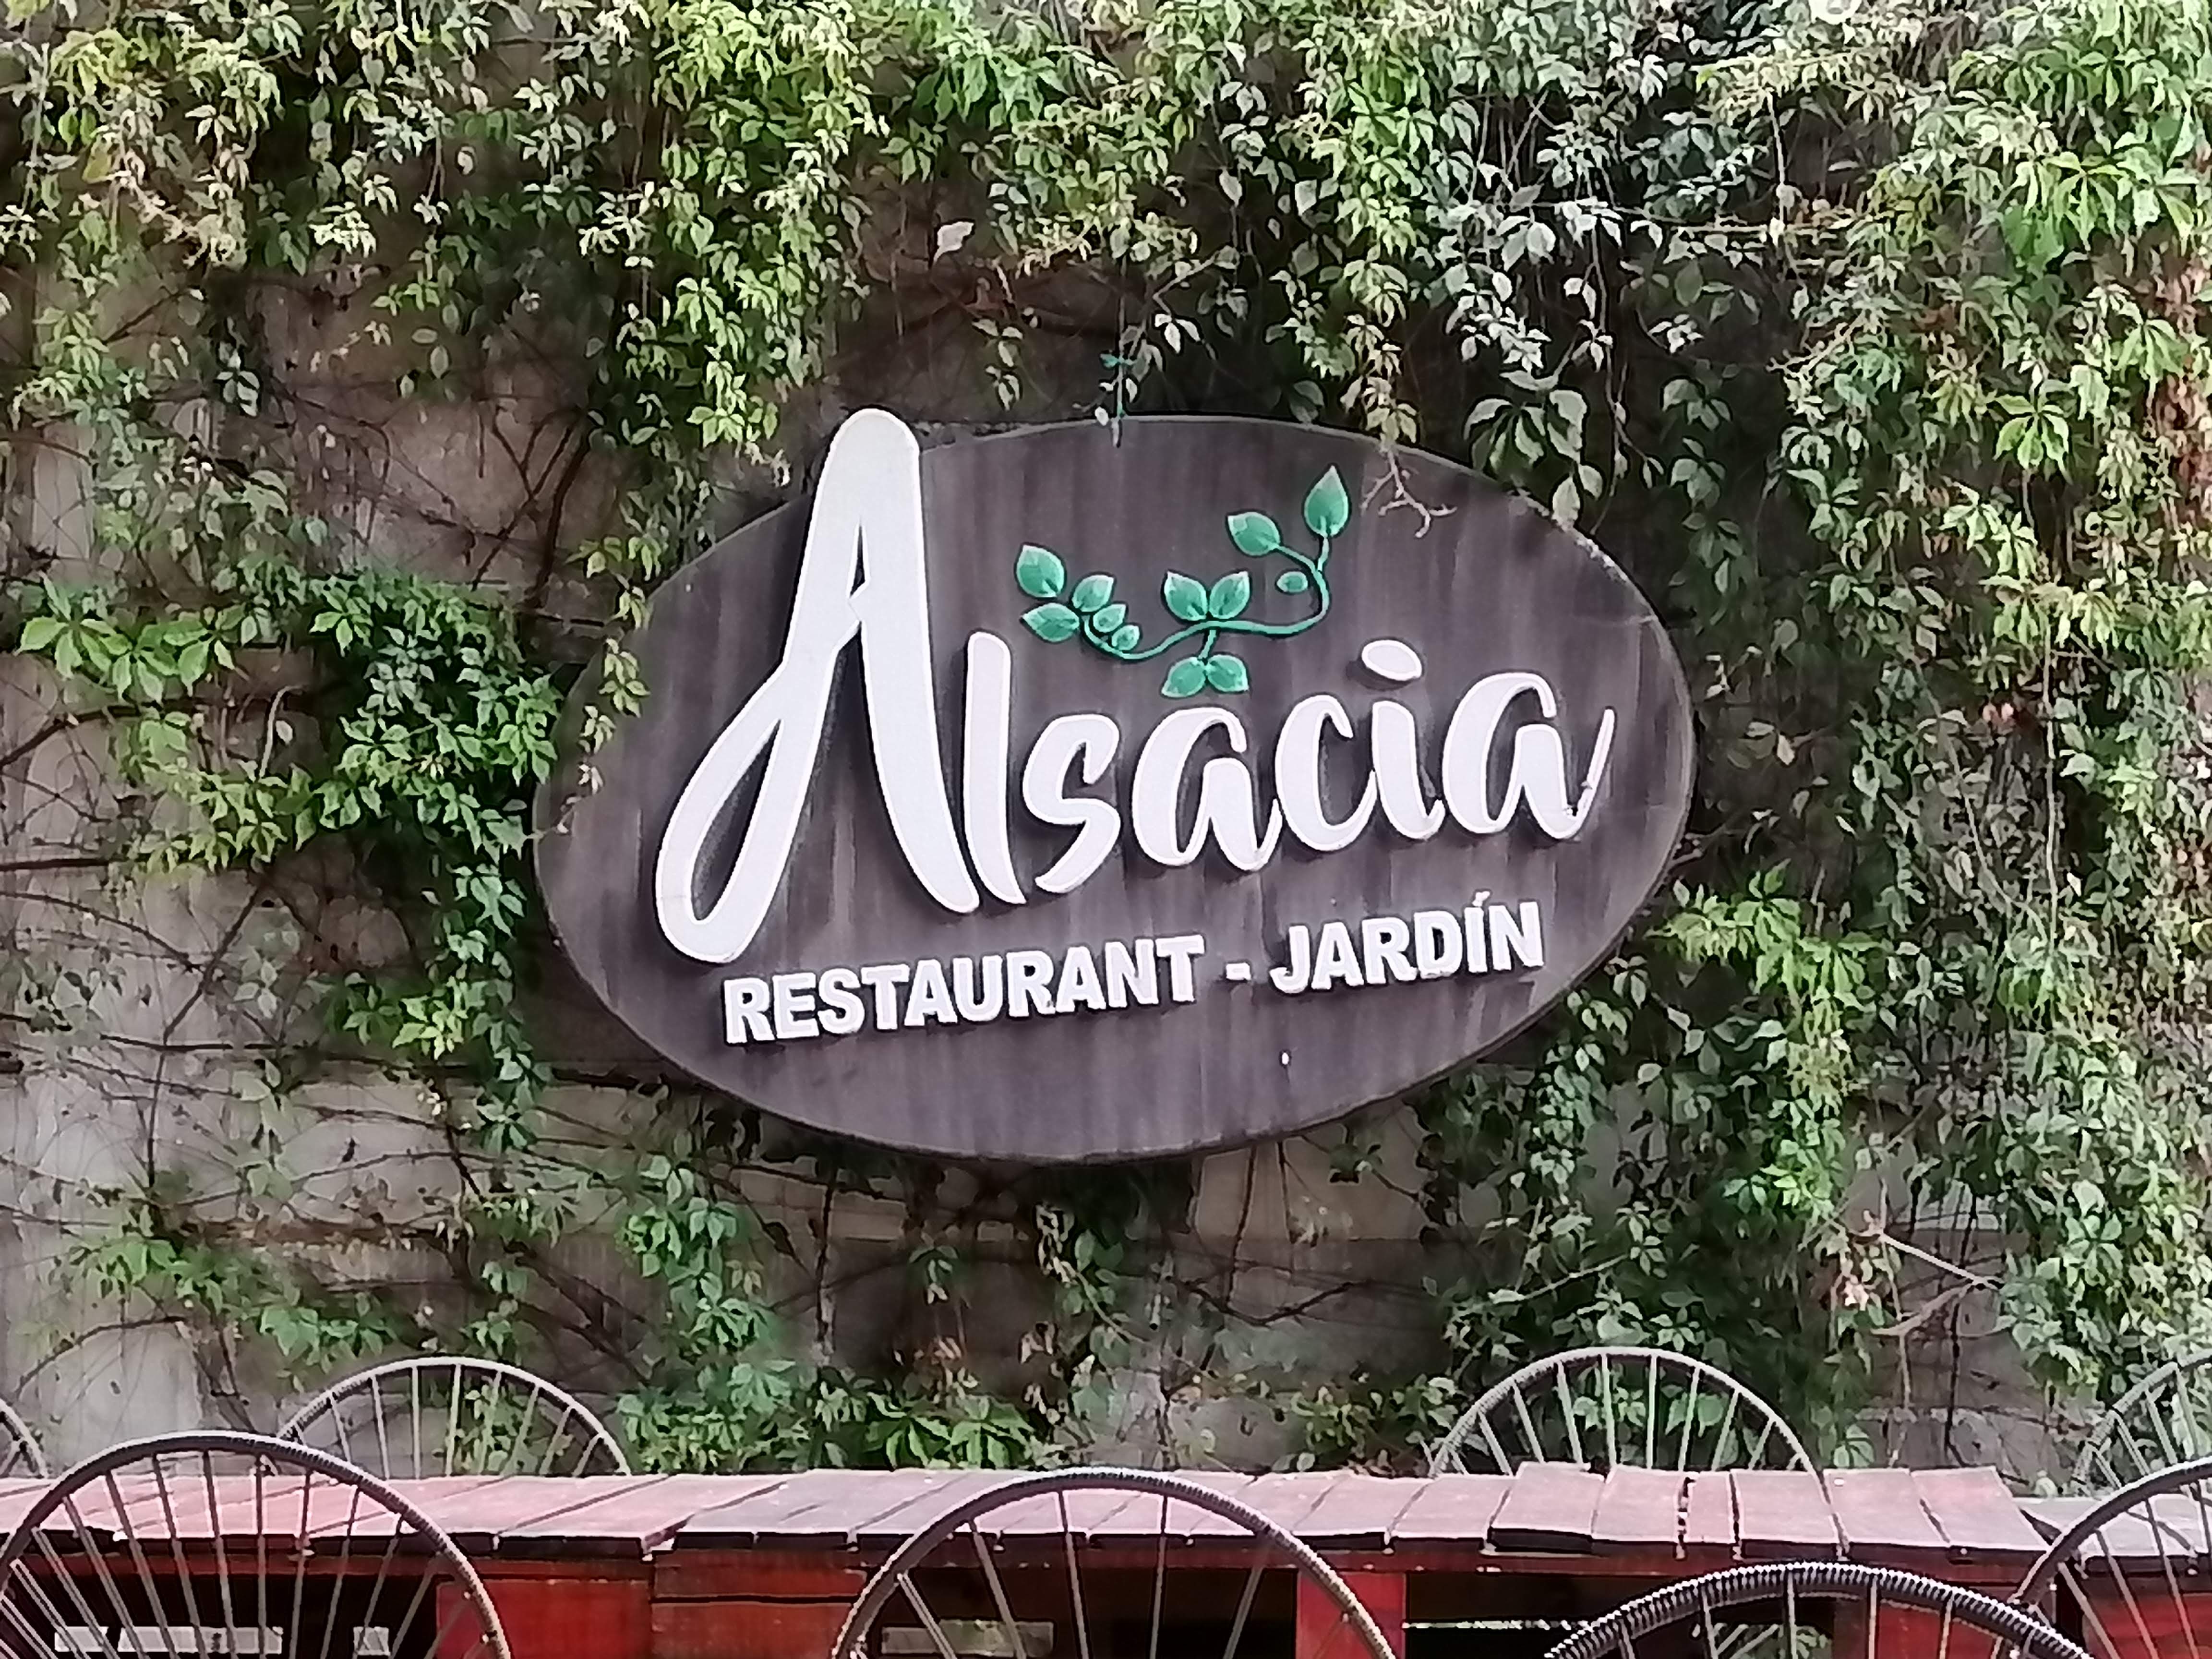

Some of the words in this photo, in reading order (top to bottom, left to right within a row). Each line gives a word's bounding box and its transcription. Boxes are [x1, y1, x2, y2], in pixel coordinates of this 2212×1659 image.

[655, 408, 1616, 963] Alsacia
[723, 934, 1205, 1044] RESTAURANT
[1225, 962, 1252, 981] -
[1269, 890, 1545, 996] JARDÍN
